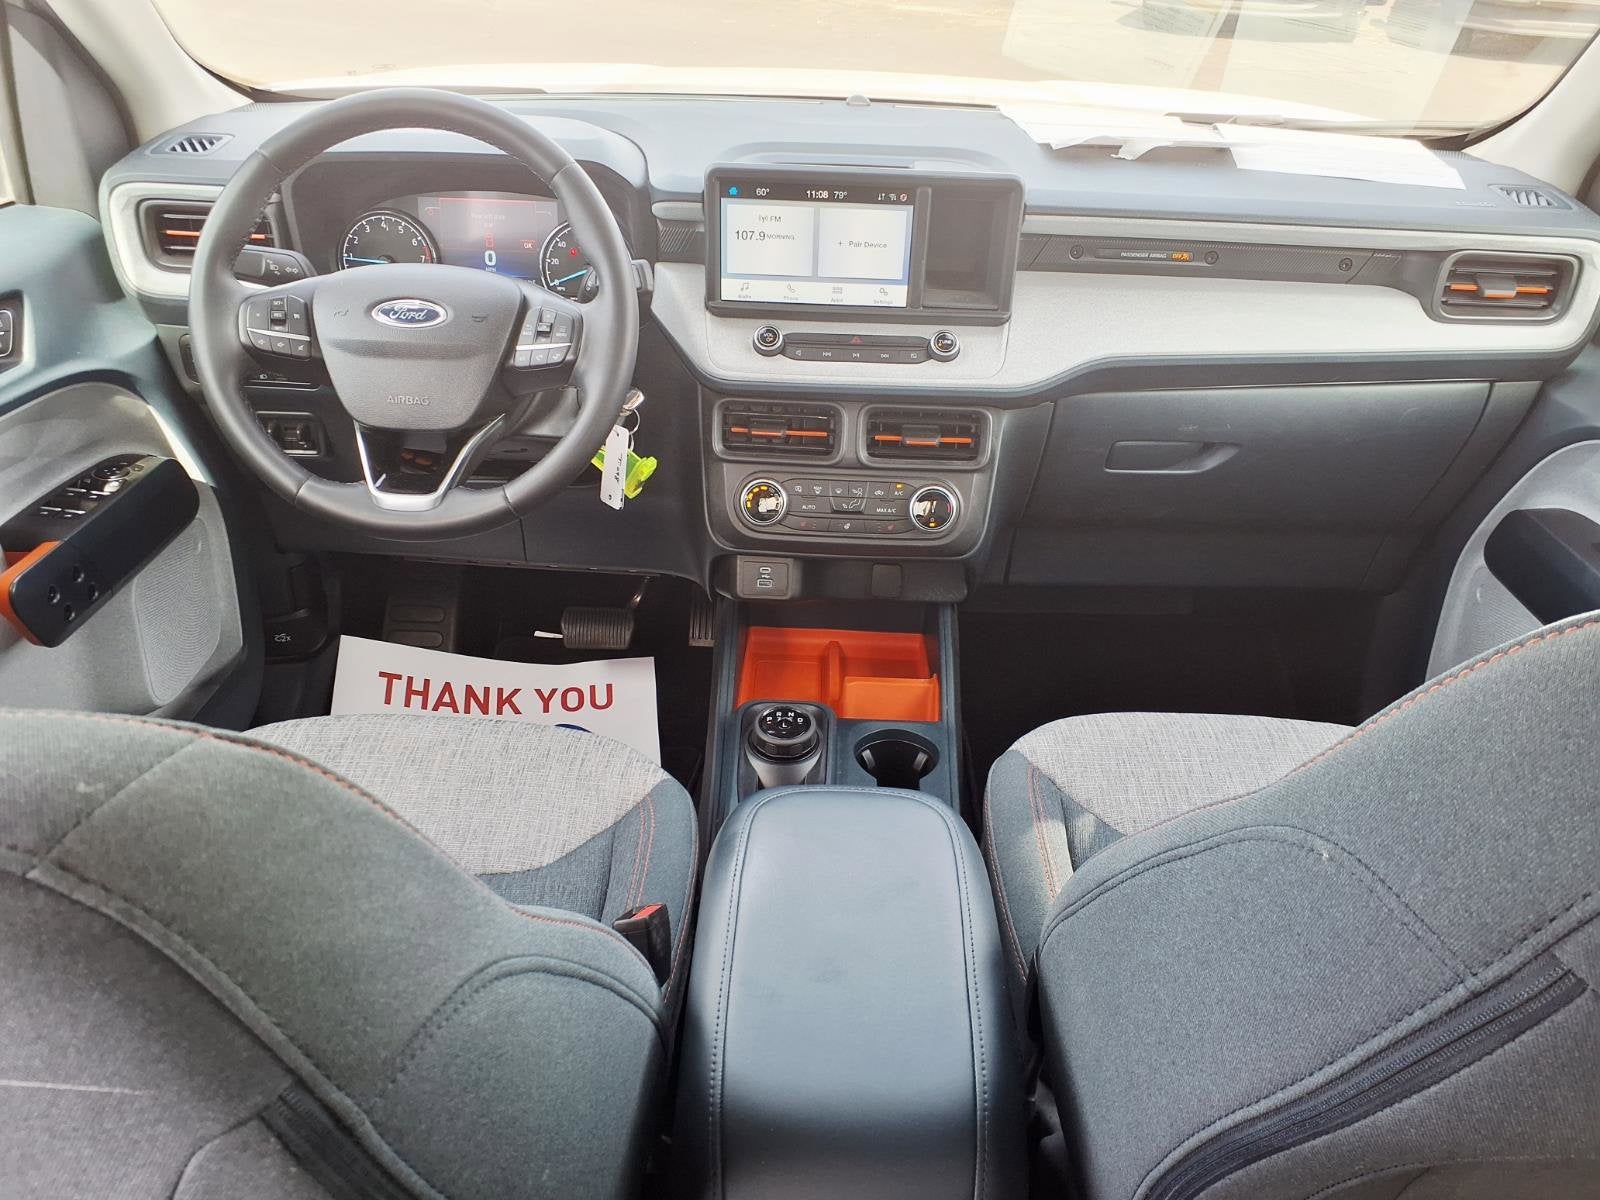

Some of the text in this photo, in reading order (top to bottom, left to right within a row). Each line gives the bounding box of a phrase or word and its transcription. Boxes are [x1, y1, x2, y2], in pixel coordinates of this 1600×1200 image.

[806, 190, 829, 199] 11:08
[353, 236, 359, 244] 2
[735, 230, 766, 241] 107.9
[848, 240, 888, 249] Pair Device
[484, 250, 497, 266] 0
[389, 304, 428, 321] Ford
[387, 394, 430, 406] AIRBAG
[378, 671, 614, 716] THANK YOU
